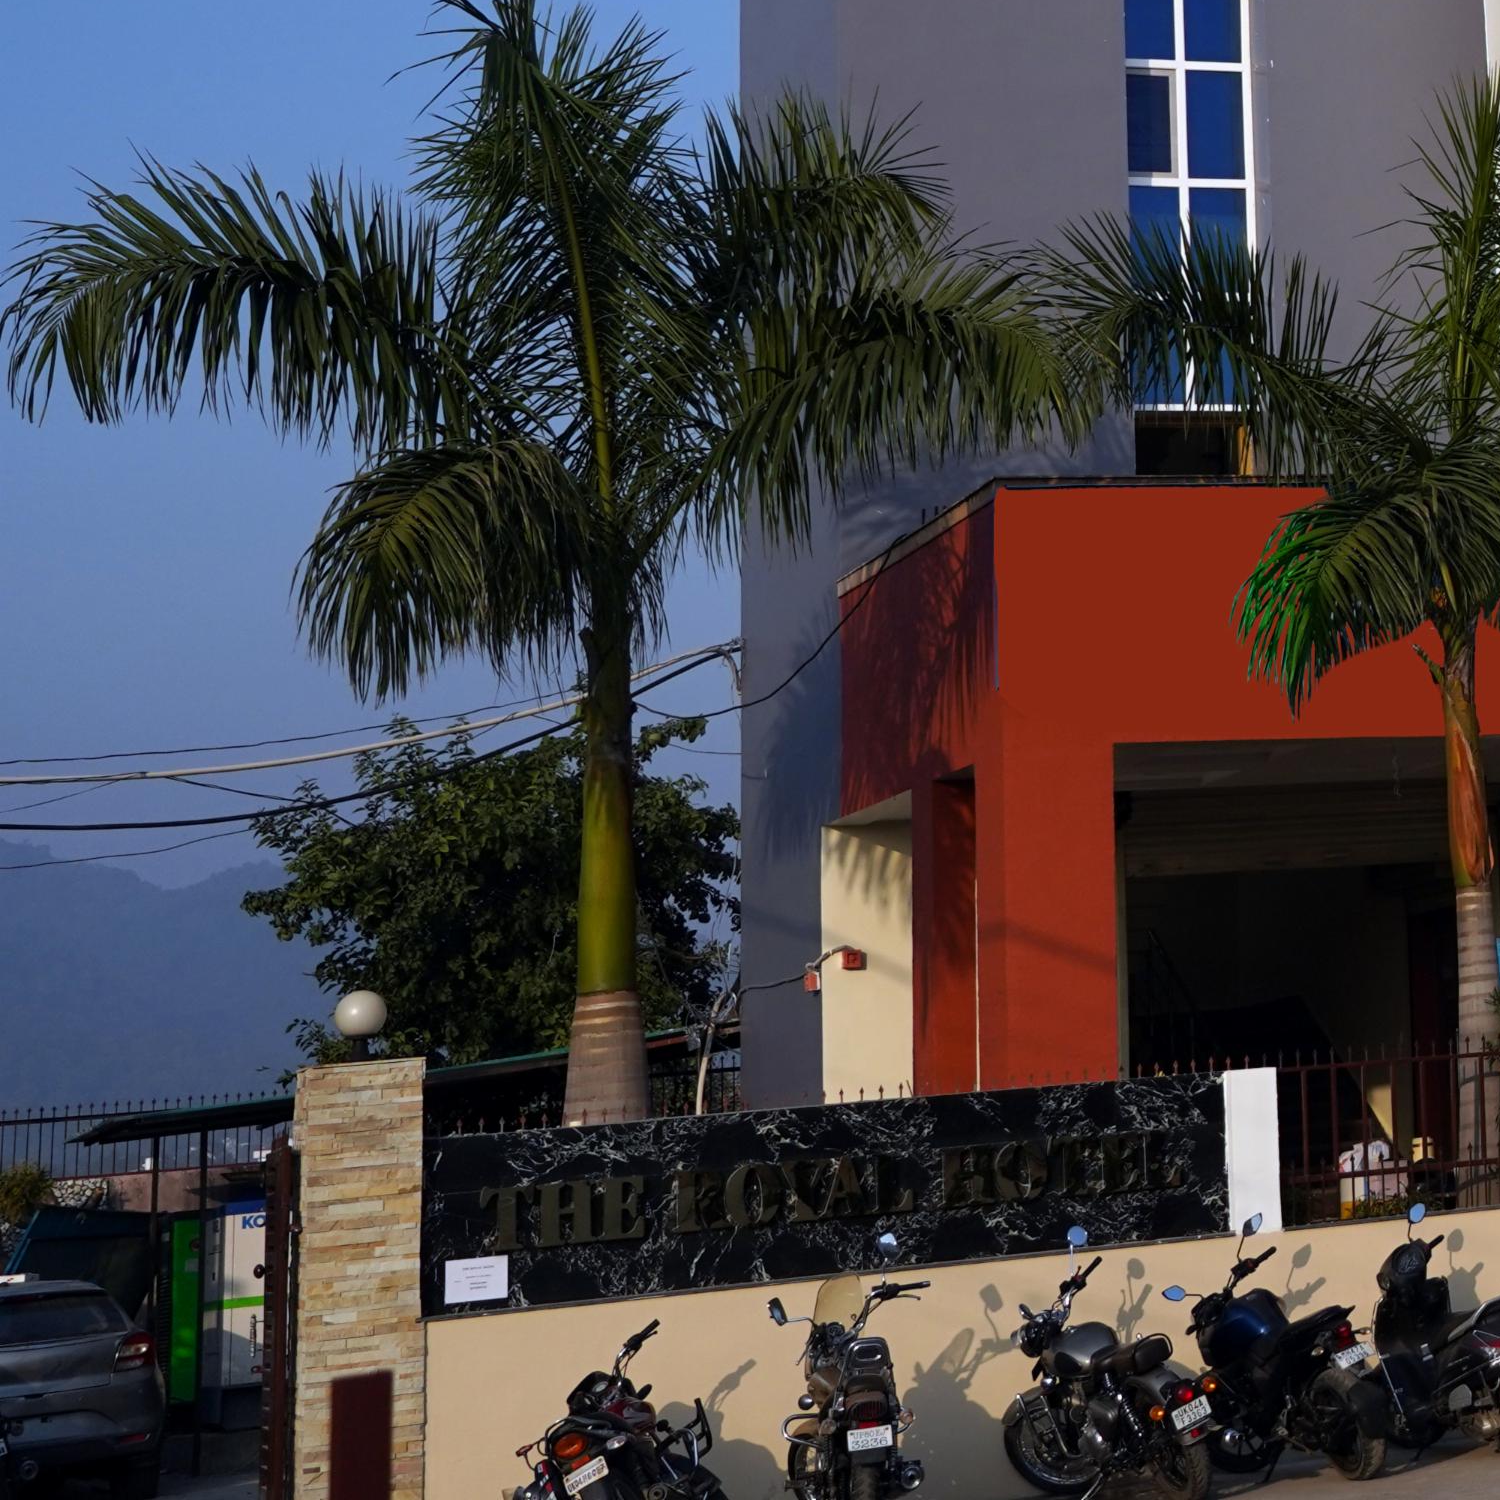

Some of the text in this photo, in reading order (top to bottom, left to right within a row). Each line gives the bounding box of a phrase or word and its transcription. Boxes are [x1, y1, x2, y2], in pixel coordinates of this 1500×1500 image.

[480, 1132, 1183, 1252] THE ROYAL HOTEL
[1178, 1399, 1203, 1417] UK04A
[852, 1436, 888, 1450] 3236
